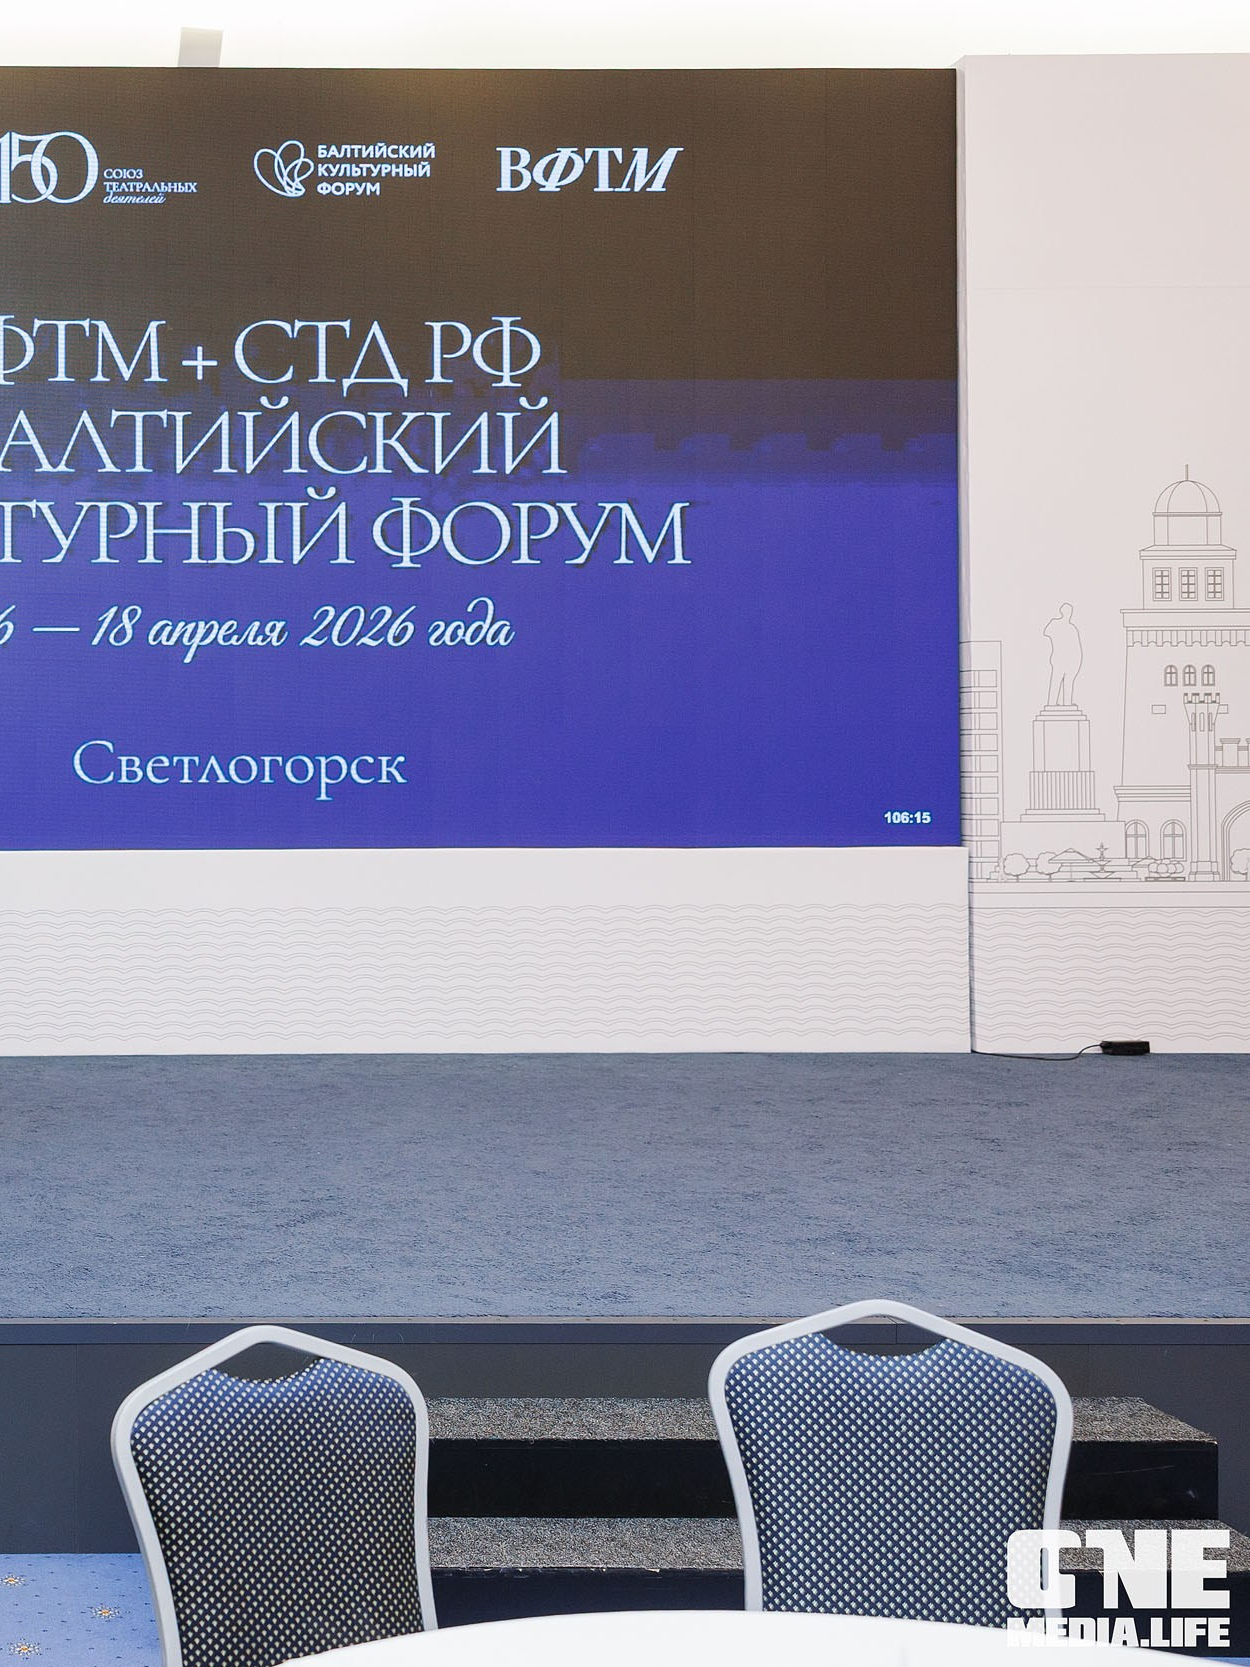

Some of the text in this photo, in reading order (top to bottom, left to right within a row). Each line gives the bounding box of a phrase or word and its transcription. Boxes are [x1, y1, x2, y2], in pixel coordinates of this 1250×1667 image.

[317, 142, 436, 159] БАЛТИЙСКИЙ
[103, 168, 144, 179] СОЮЗ
[317, 161, 431, 177] КУЛЬТУРНЫЙ
[495, 147, 684, 192] ВФТМ
[103, 181, 198, 193] ТЕАТРАЛЬНЫХ
[316, 181, 381, 196] ФОРУМ
[181, 345, 218, 381] +
[234, 318, 409, 398] СТД
[424, 316, 541, 387] РФ
[372, 497, 692, 568] ФОРУМ
[91, 605, 142, 646] 18
[148, 619, 288, 664] апреля
[299, 605, 416, 647] 2026
[428, 597, 516, 646] года
[73, 740, 407, 801] Светлогорск
[884, 811, 931, 824] 106:15
